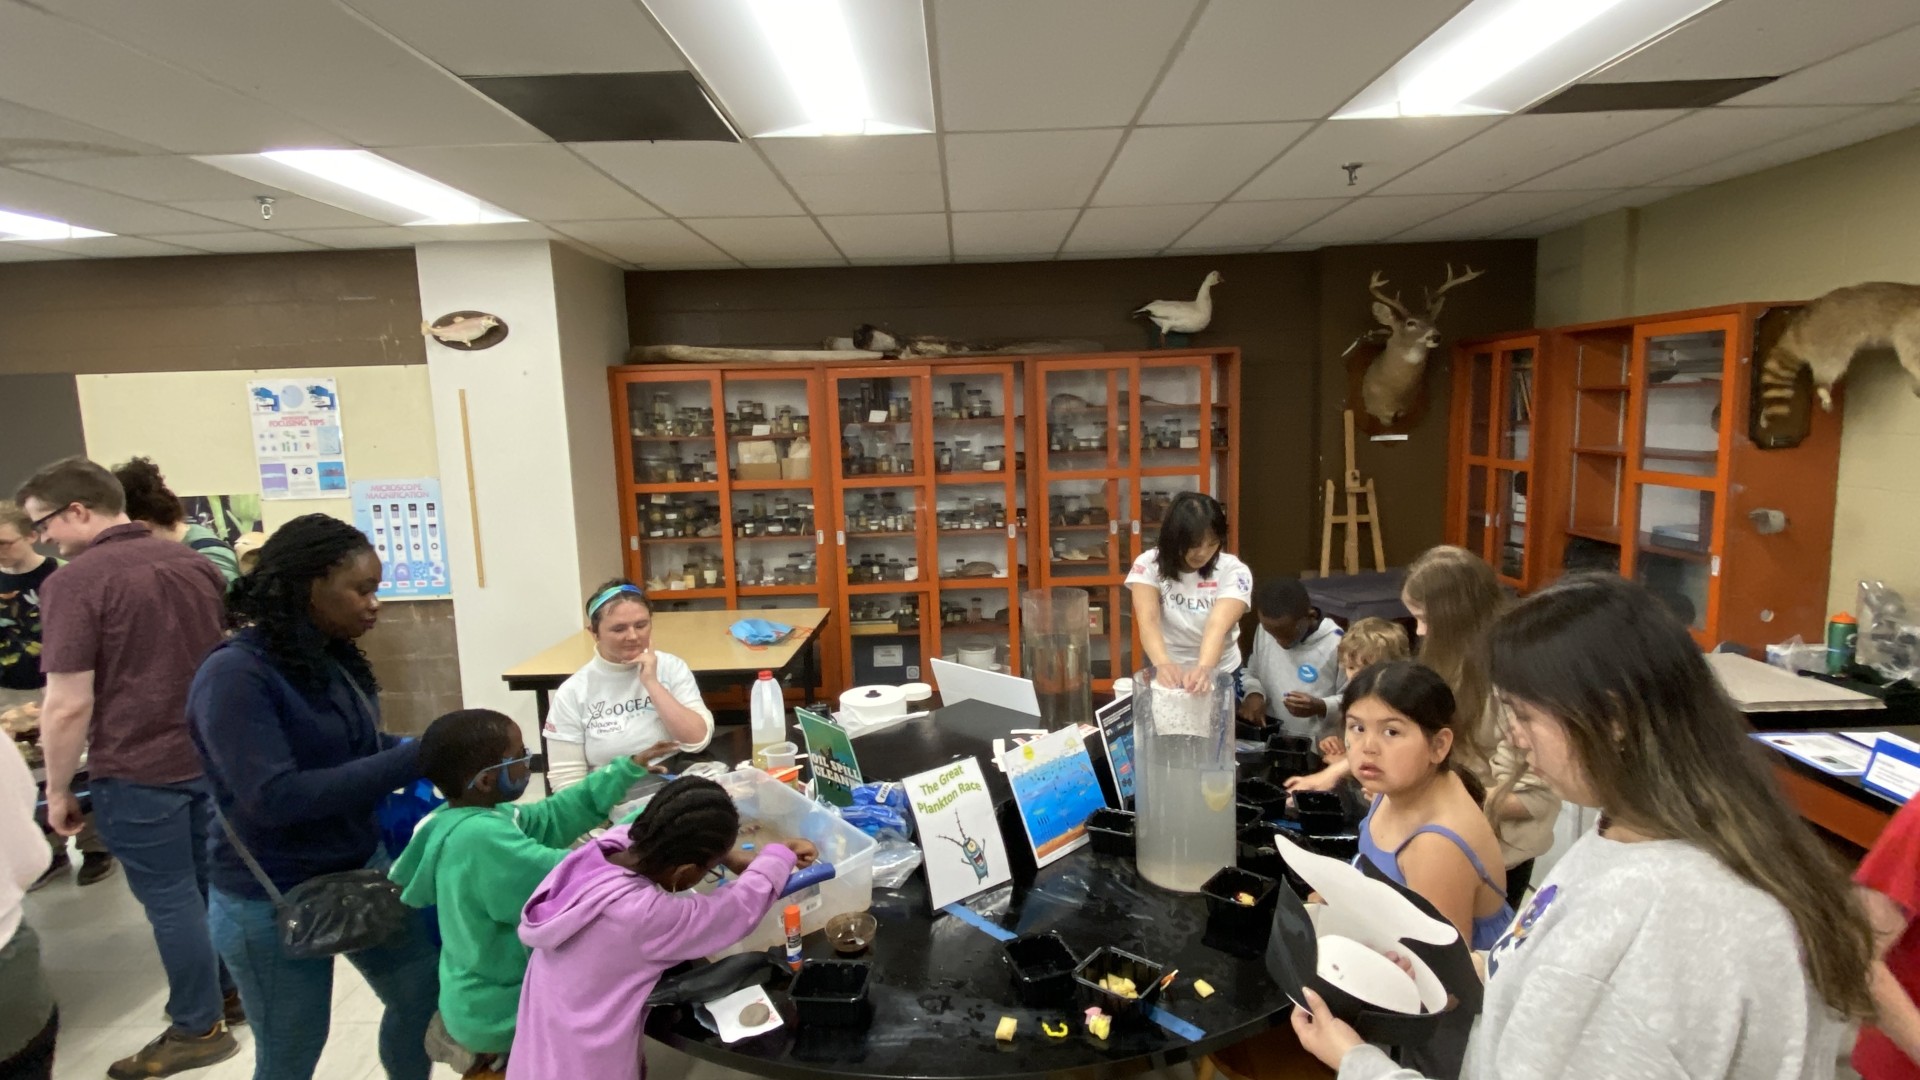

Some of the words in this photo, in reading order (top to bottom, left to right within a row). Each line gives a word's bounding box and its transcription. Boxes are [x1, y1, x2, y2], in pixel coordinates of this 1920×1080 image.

[366, 491, 430, 499] MAGNIFICATION
[371, 484, 423, 492] MICROSCOPE
[811, 753, 829, 766] OIL
[830, 760, 860, 780] SPILL
[920, 782, 939, 796] The
[939, 765, 964, 786] Great
[917, 790, 958, 813] Plankton
[958, 782, 982, 794] Race
